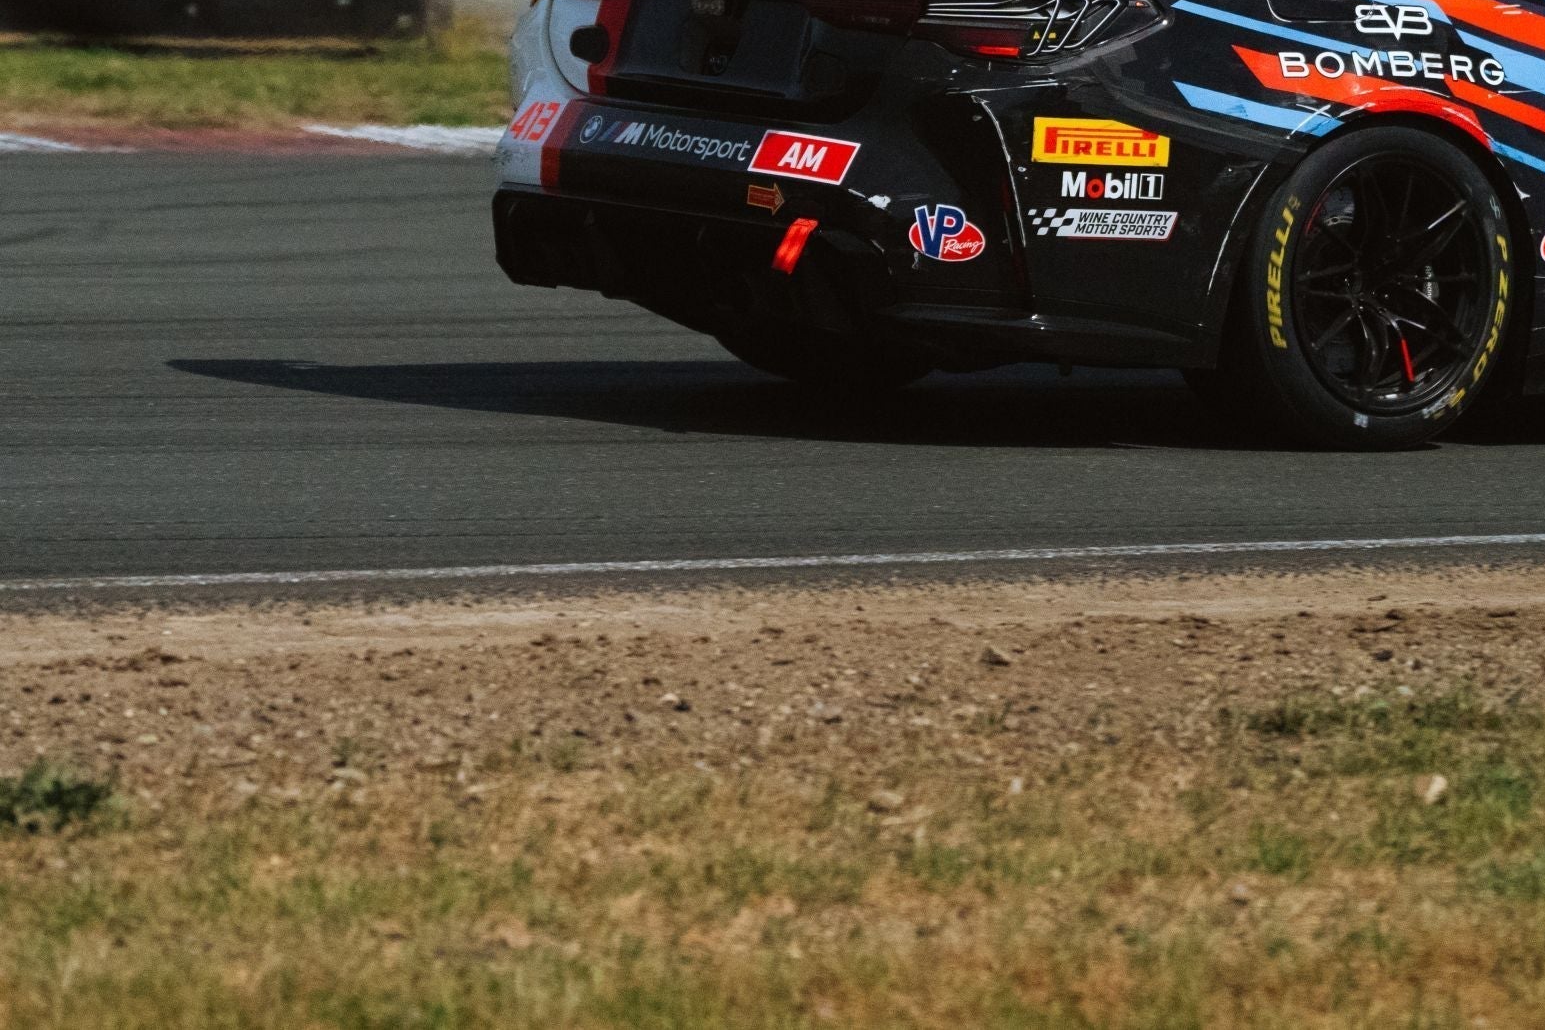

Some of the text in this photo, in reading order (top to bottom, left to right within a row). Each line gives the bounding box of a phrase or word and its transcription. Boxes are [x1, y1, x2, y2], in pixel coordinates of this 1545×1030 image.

[1278, 50, 1505, 86] BOMBERG
[508, 101, 560, 142] 413
[641, 123, 752, 162] Motorsport
[777, 141, 828, 172] AM
[1043, 126, 1159, 158] PIRELLI
[914, 204, 967, 259] VP
[1074, 223, 1168, 237] MOTOR SPORTS
[1078, 211, 1172, 226] WINE COUNTRY
[943, 237, 984, 255] Racing
[1266, 206, 1295, 349] PIRELLI
[1472, 269, 1509, 383] ZERO
